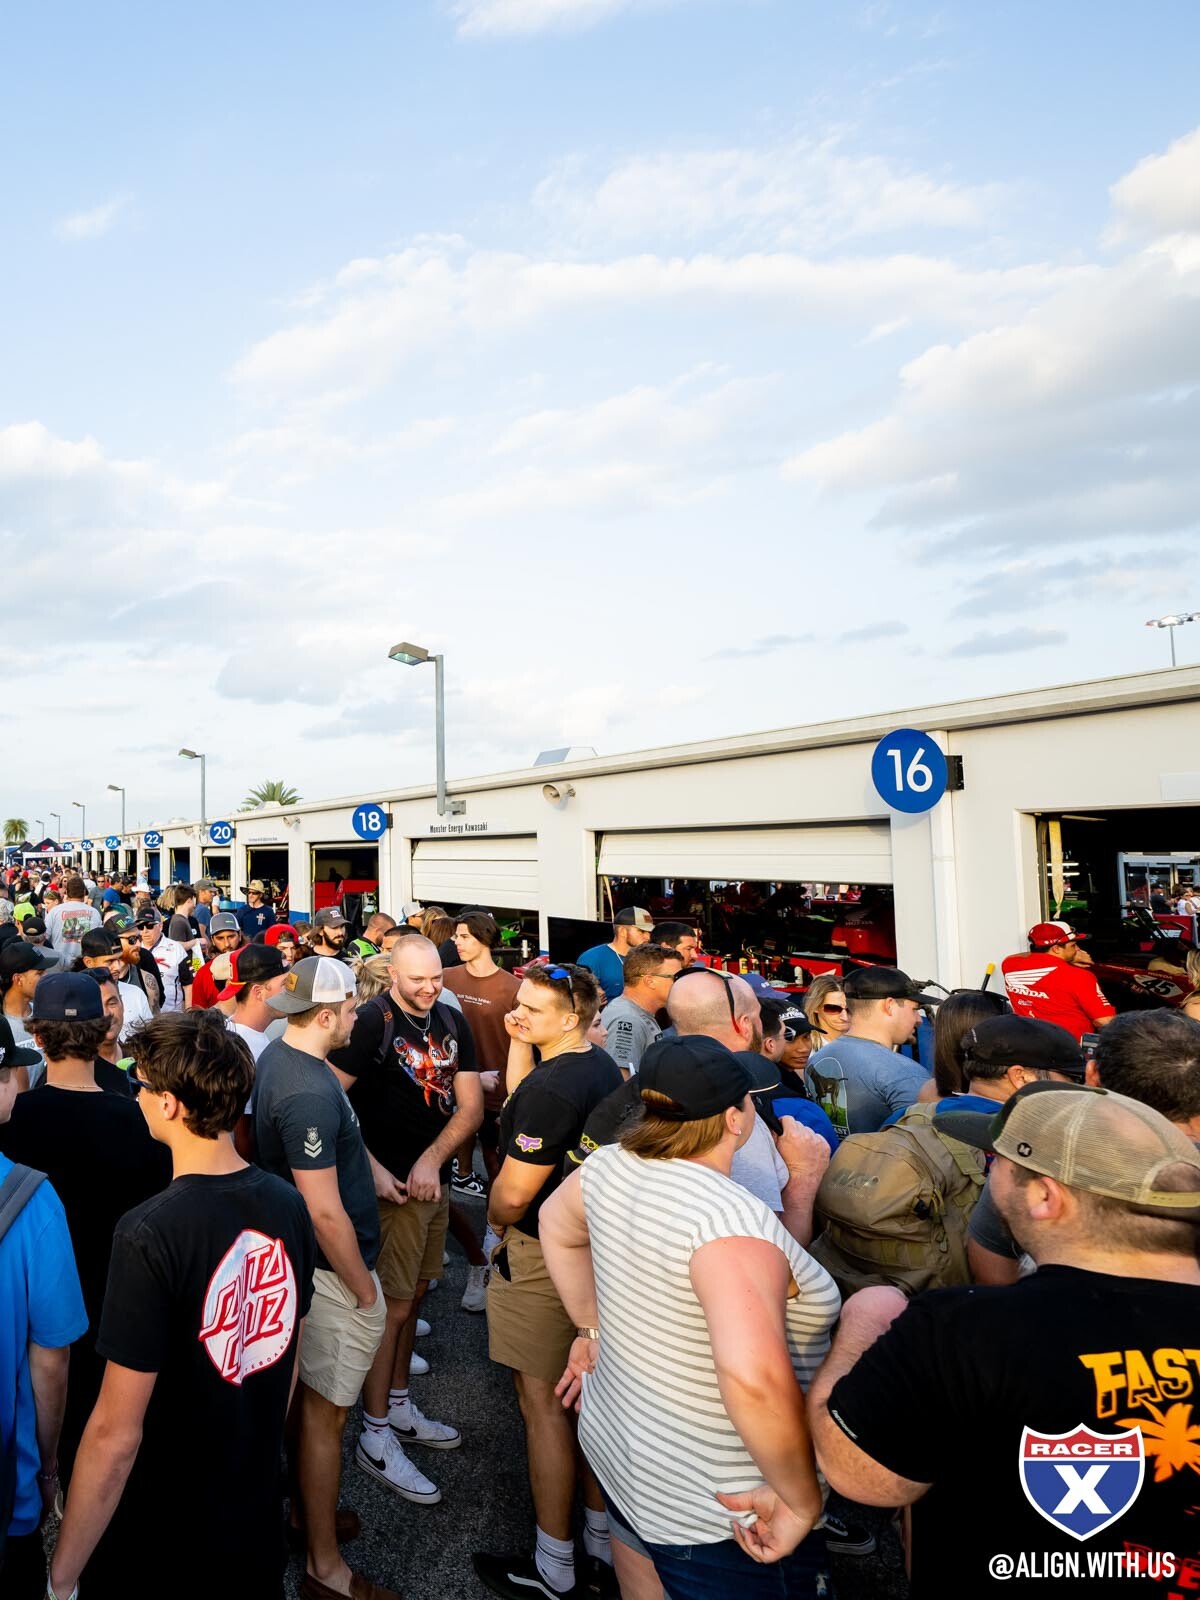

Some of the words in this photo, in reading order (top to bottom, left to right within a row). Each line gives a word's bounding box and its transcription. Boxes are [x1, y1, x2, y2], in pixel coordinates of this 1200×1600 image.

[886, 747, 933, 793] 16
[359, 811, 381, 832] 18
[429, 825, 447, 833] Monster
[448, 824, 464, 834] Energy
[464, 821, 488, 832] Kawasaki
[146, 835, 160, 845] 22
[213, 826, 231, 840] 20
[107, 839, 118, 847] 24
[1006, 985, 1050, 999] HONDA
[1138, 979, 1172, 997] 45
